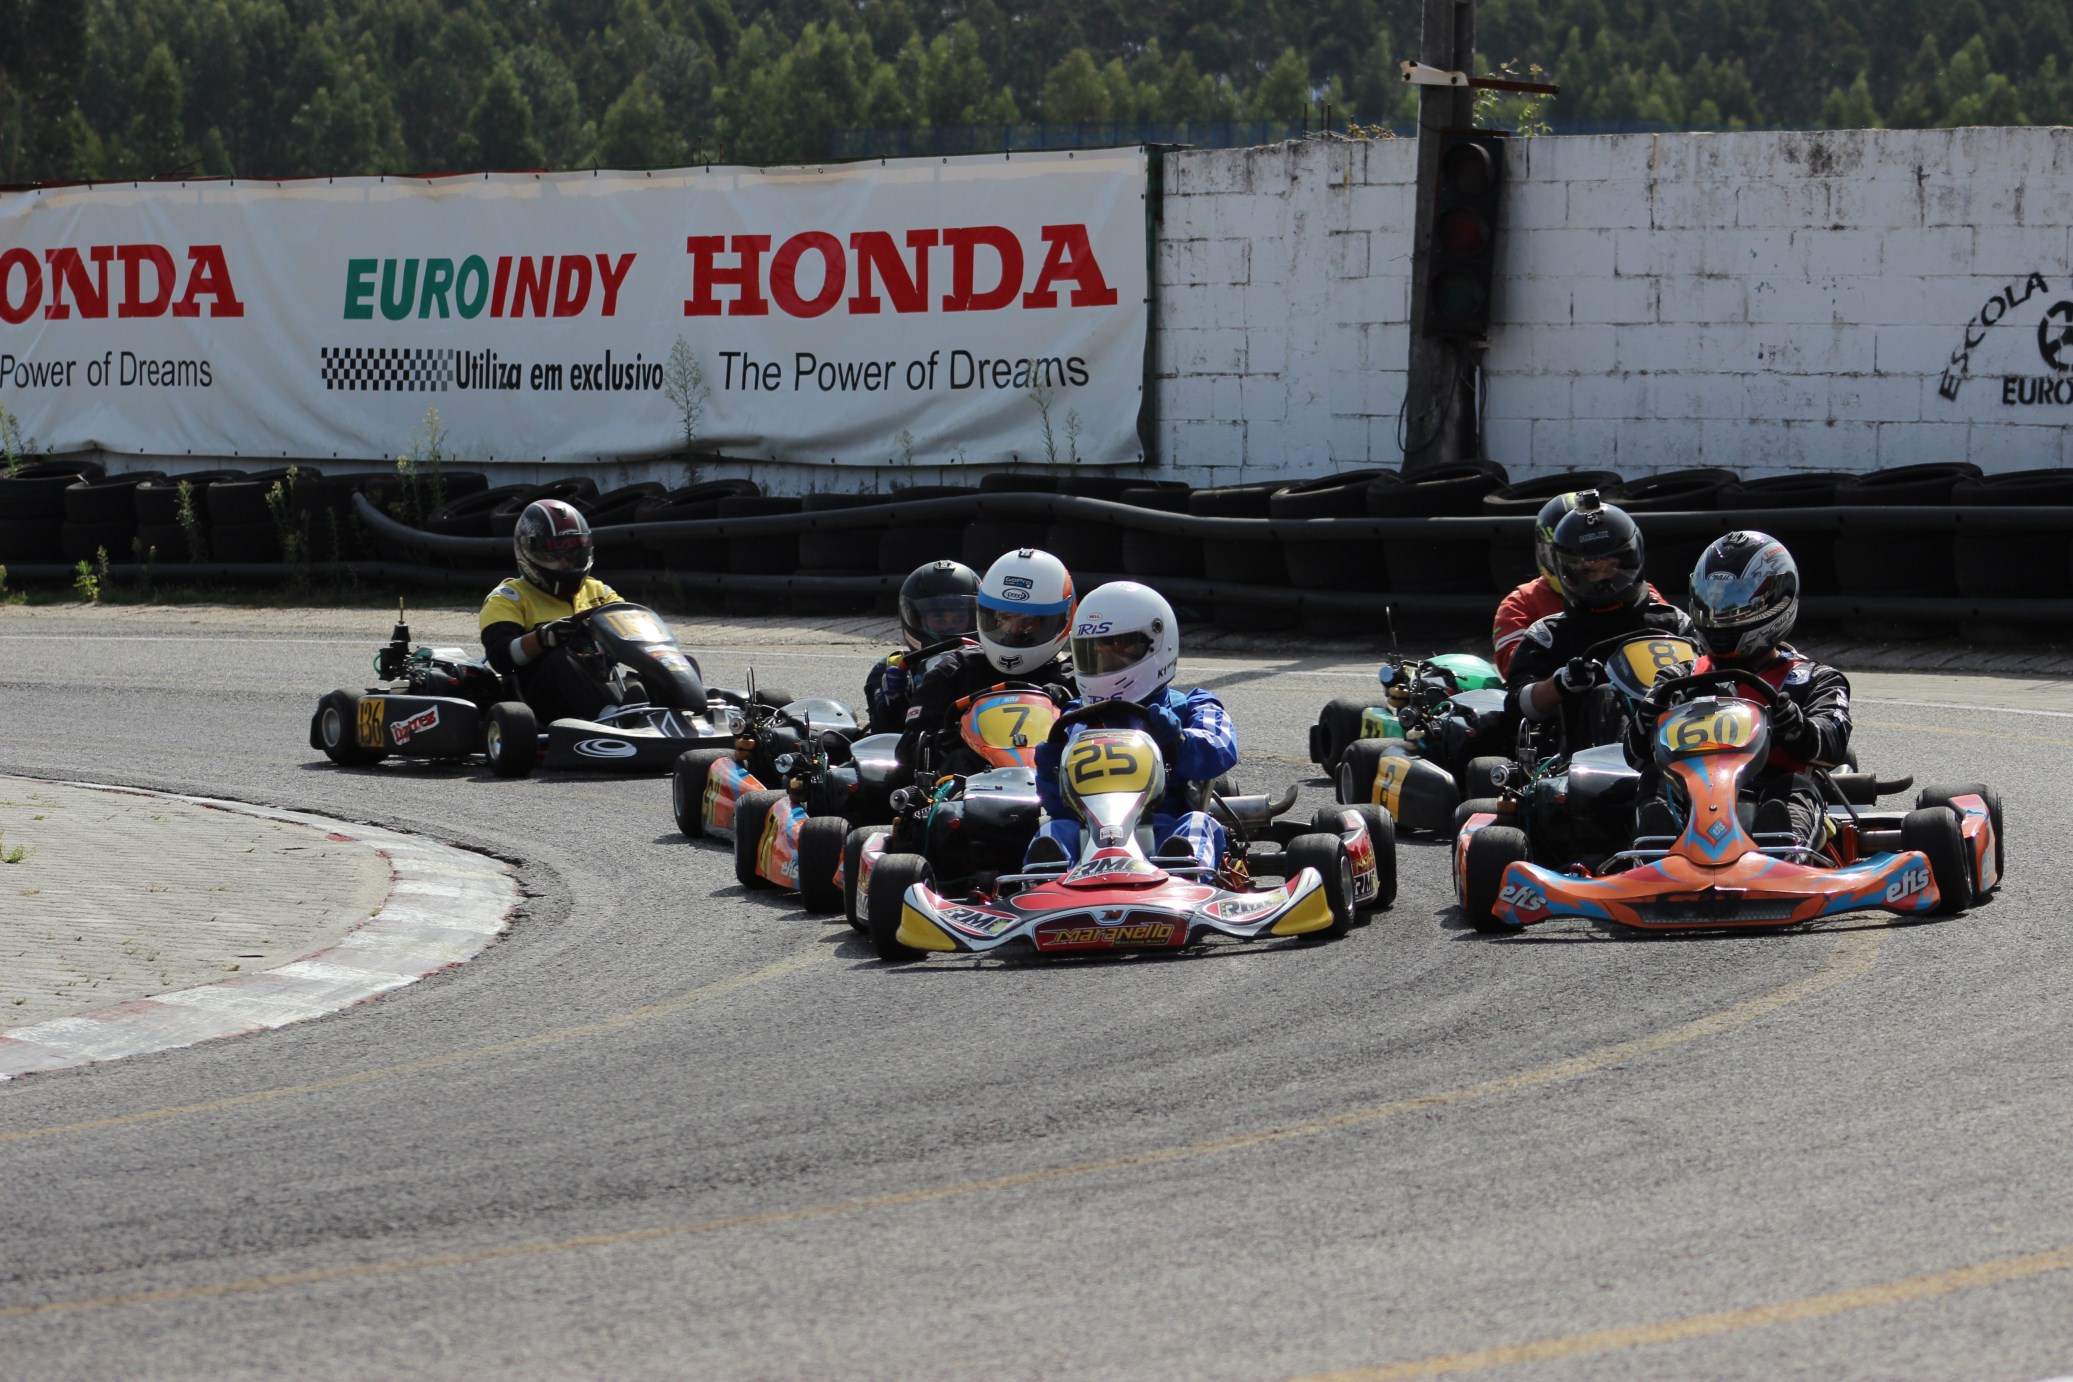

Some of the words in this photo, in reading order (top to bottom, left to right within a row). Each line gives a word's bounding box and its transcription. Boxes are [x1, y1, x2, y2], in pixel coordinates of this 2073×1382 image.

[0, 244, 244, 324] ONDA
[343, 253, 637, 321] EUROINDY
[684, 223, 1118, 318] HONDA
[1938, 271, 2048, 402] ESCOLA
[0, 354, 77, 388] Power
[87, 351, 112, 387] of
[120, 351, 213, 388] Dreams
[455, 349, 522, 390] Utiliza
[530, 363, 563, 391] em
[570, 349, 664, 391] exclusivo
[719, 351, 782, 391] The
[794, 352, 896, 391] Power
[906, 350, 940, 391] of
[949, 349, 1090, 390] Dreams
[2002, 376, 2073, 405] EURO
[359, 701, 381, 746] 136
[1003, 706, 1030, 738] 7
[1677, 712, 1739, 748] 60
[1073, 742, 1138, 785] 25
